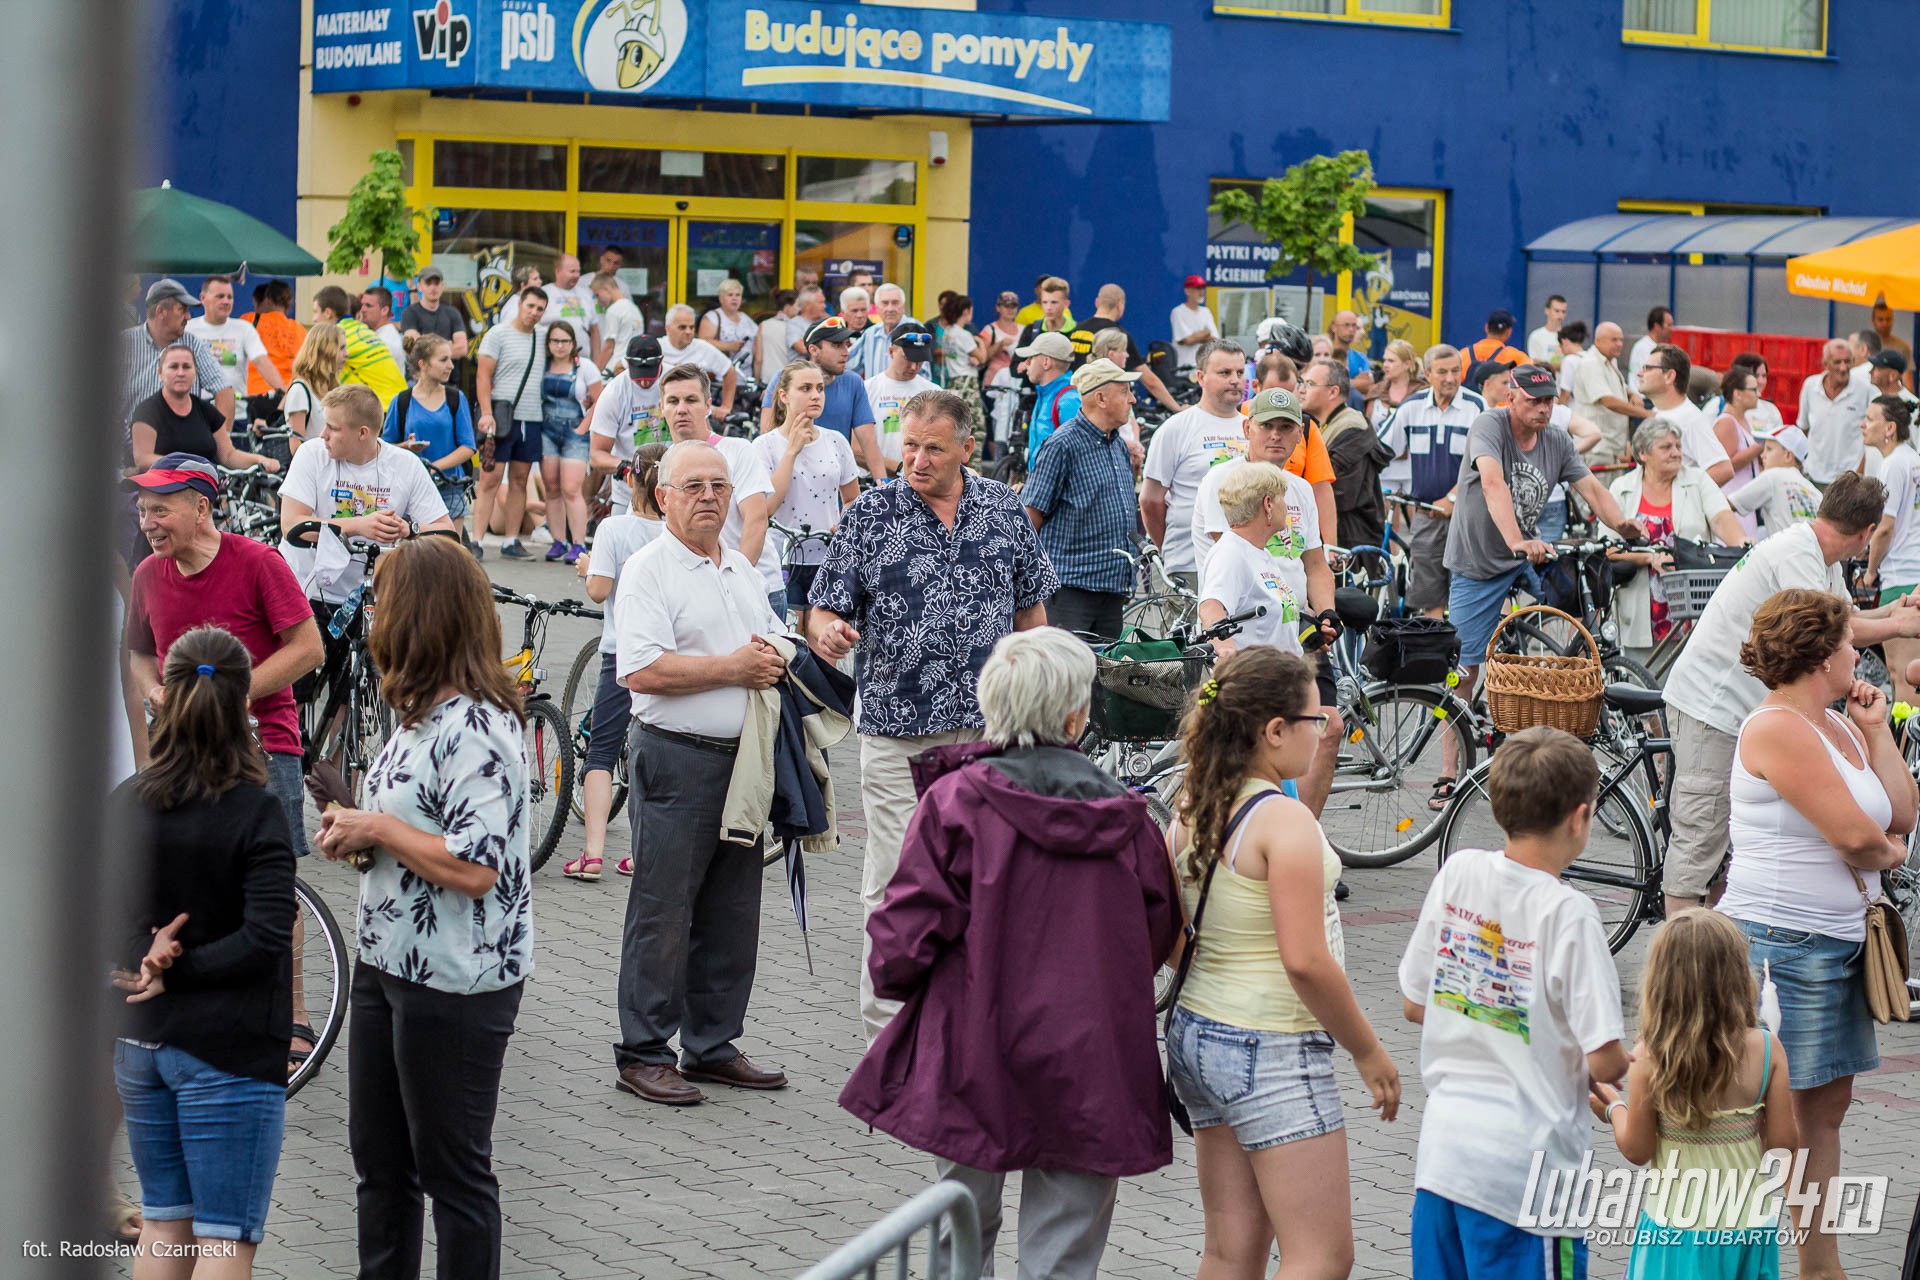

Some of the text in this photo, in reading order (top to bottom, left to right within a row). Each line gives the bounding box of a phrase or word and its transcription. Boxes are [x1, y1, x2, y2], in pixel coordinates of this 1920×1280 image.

[315, 8, 391, 37] MATERIAŁY
[501, 2, 556, 70] psb
[316, 41, 402, 70] BUDOWLANE
[745, 10, 1094, 82] Budujące pomysły
[1206, 244, 1281, 262] PŁYTKI POD
[1213, 263, 1267, 283] ŚCIENNE
